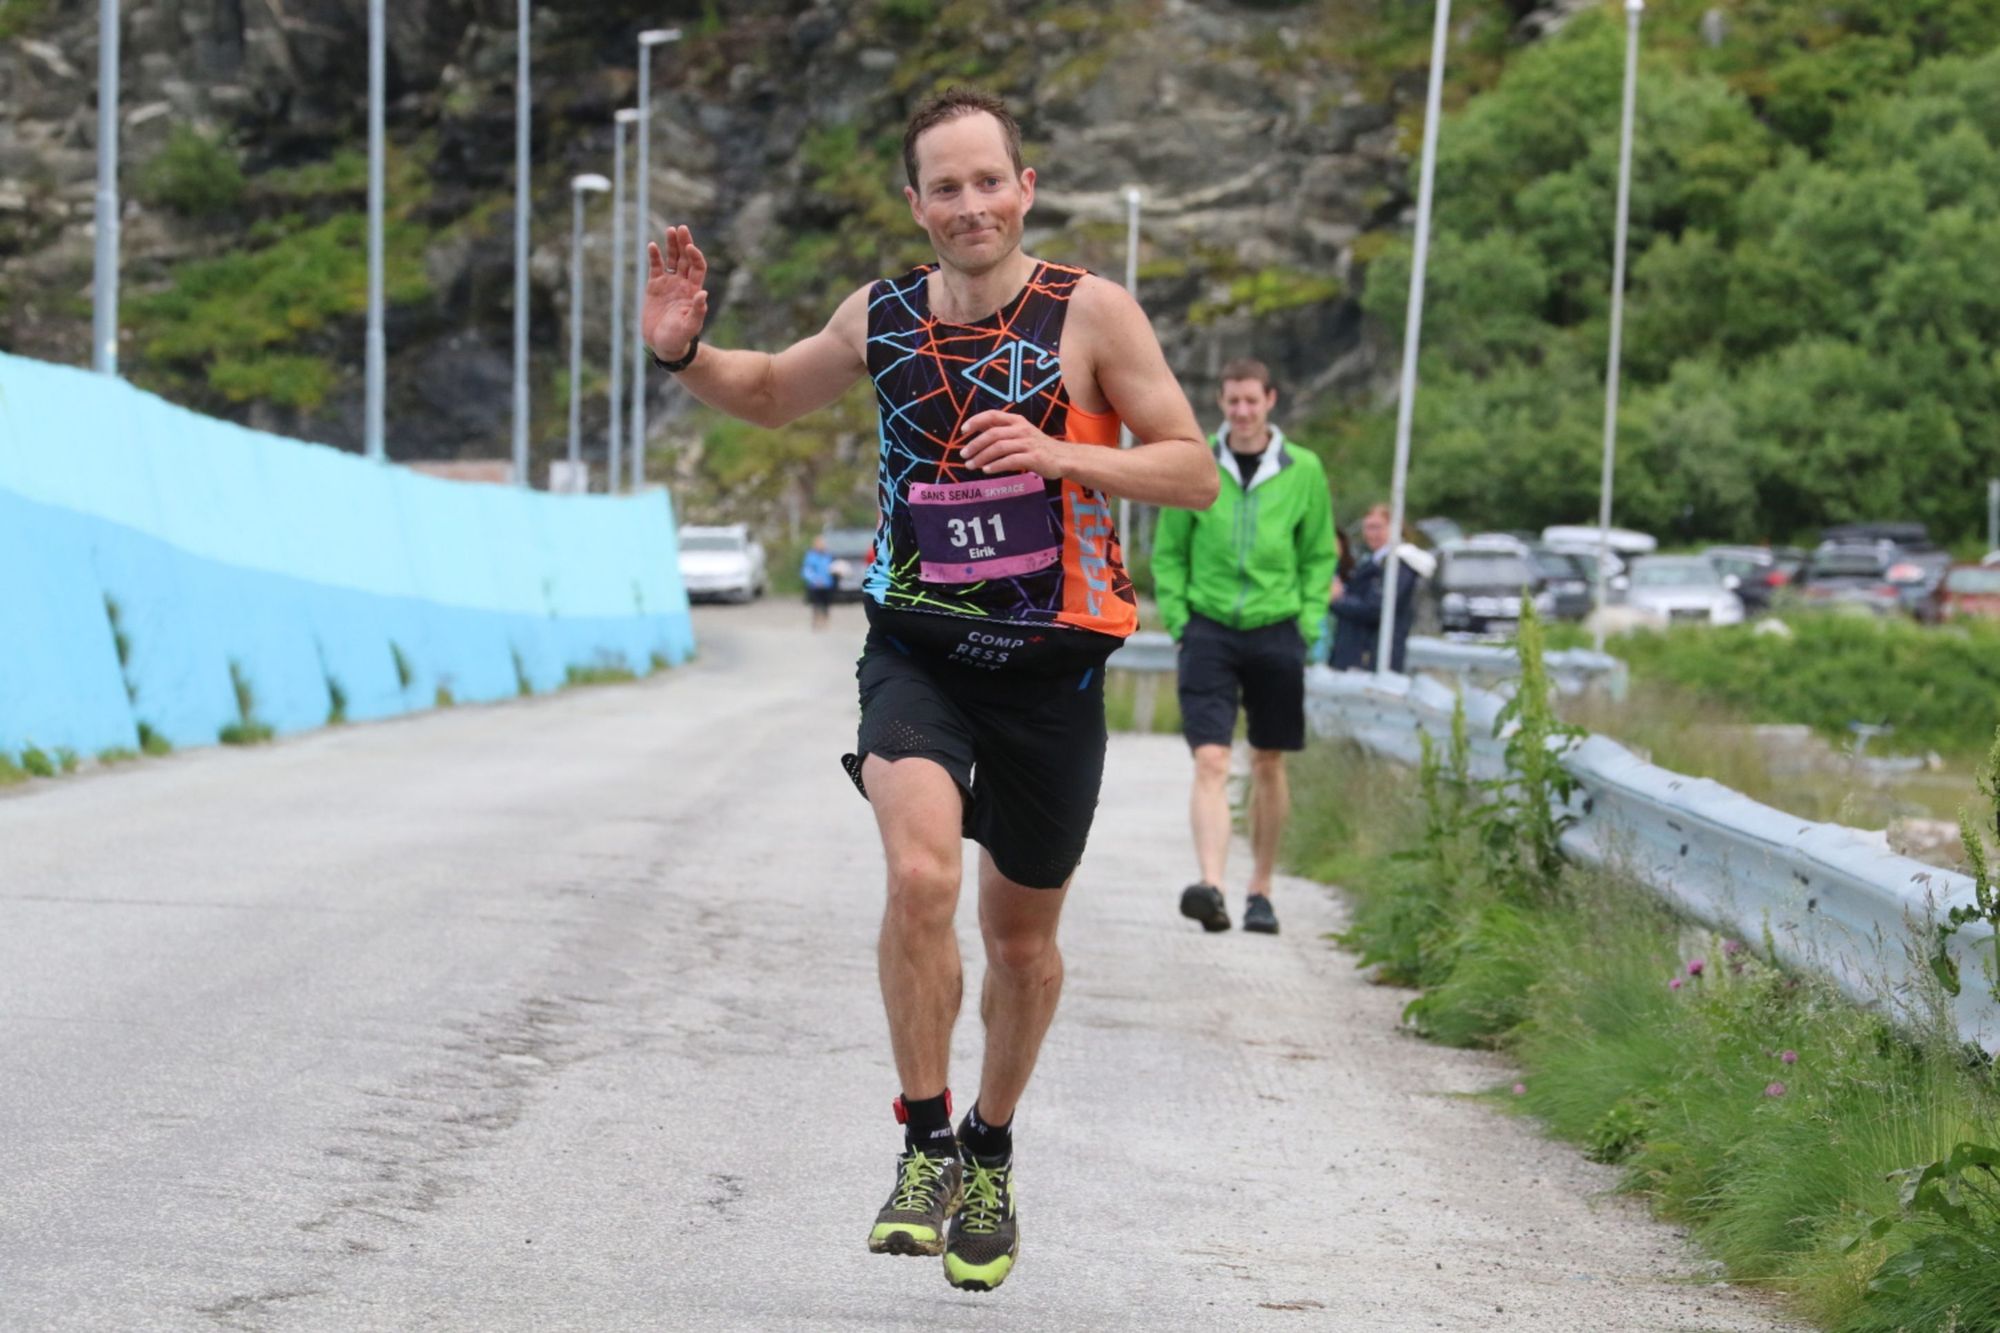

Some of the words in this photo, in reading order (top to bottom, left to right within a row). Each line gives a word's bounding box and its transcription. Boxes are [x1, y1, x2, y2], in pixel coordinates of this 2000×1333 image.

[921, 490, 945, 501] SANS
[948, 488, 982, 500] SENJA
[984, 483, 1025, 497] SKYRACE
[947, 512, 1006, 547] 311
[969, 546, 996, 559] Eirik
[968, 631, 1024, 648] COMP
[956, 643, 1010, 662] RESS
